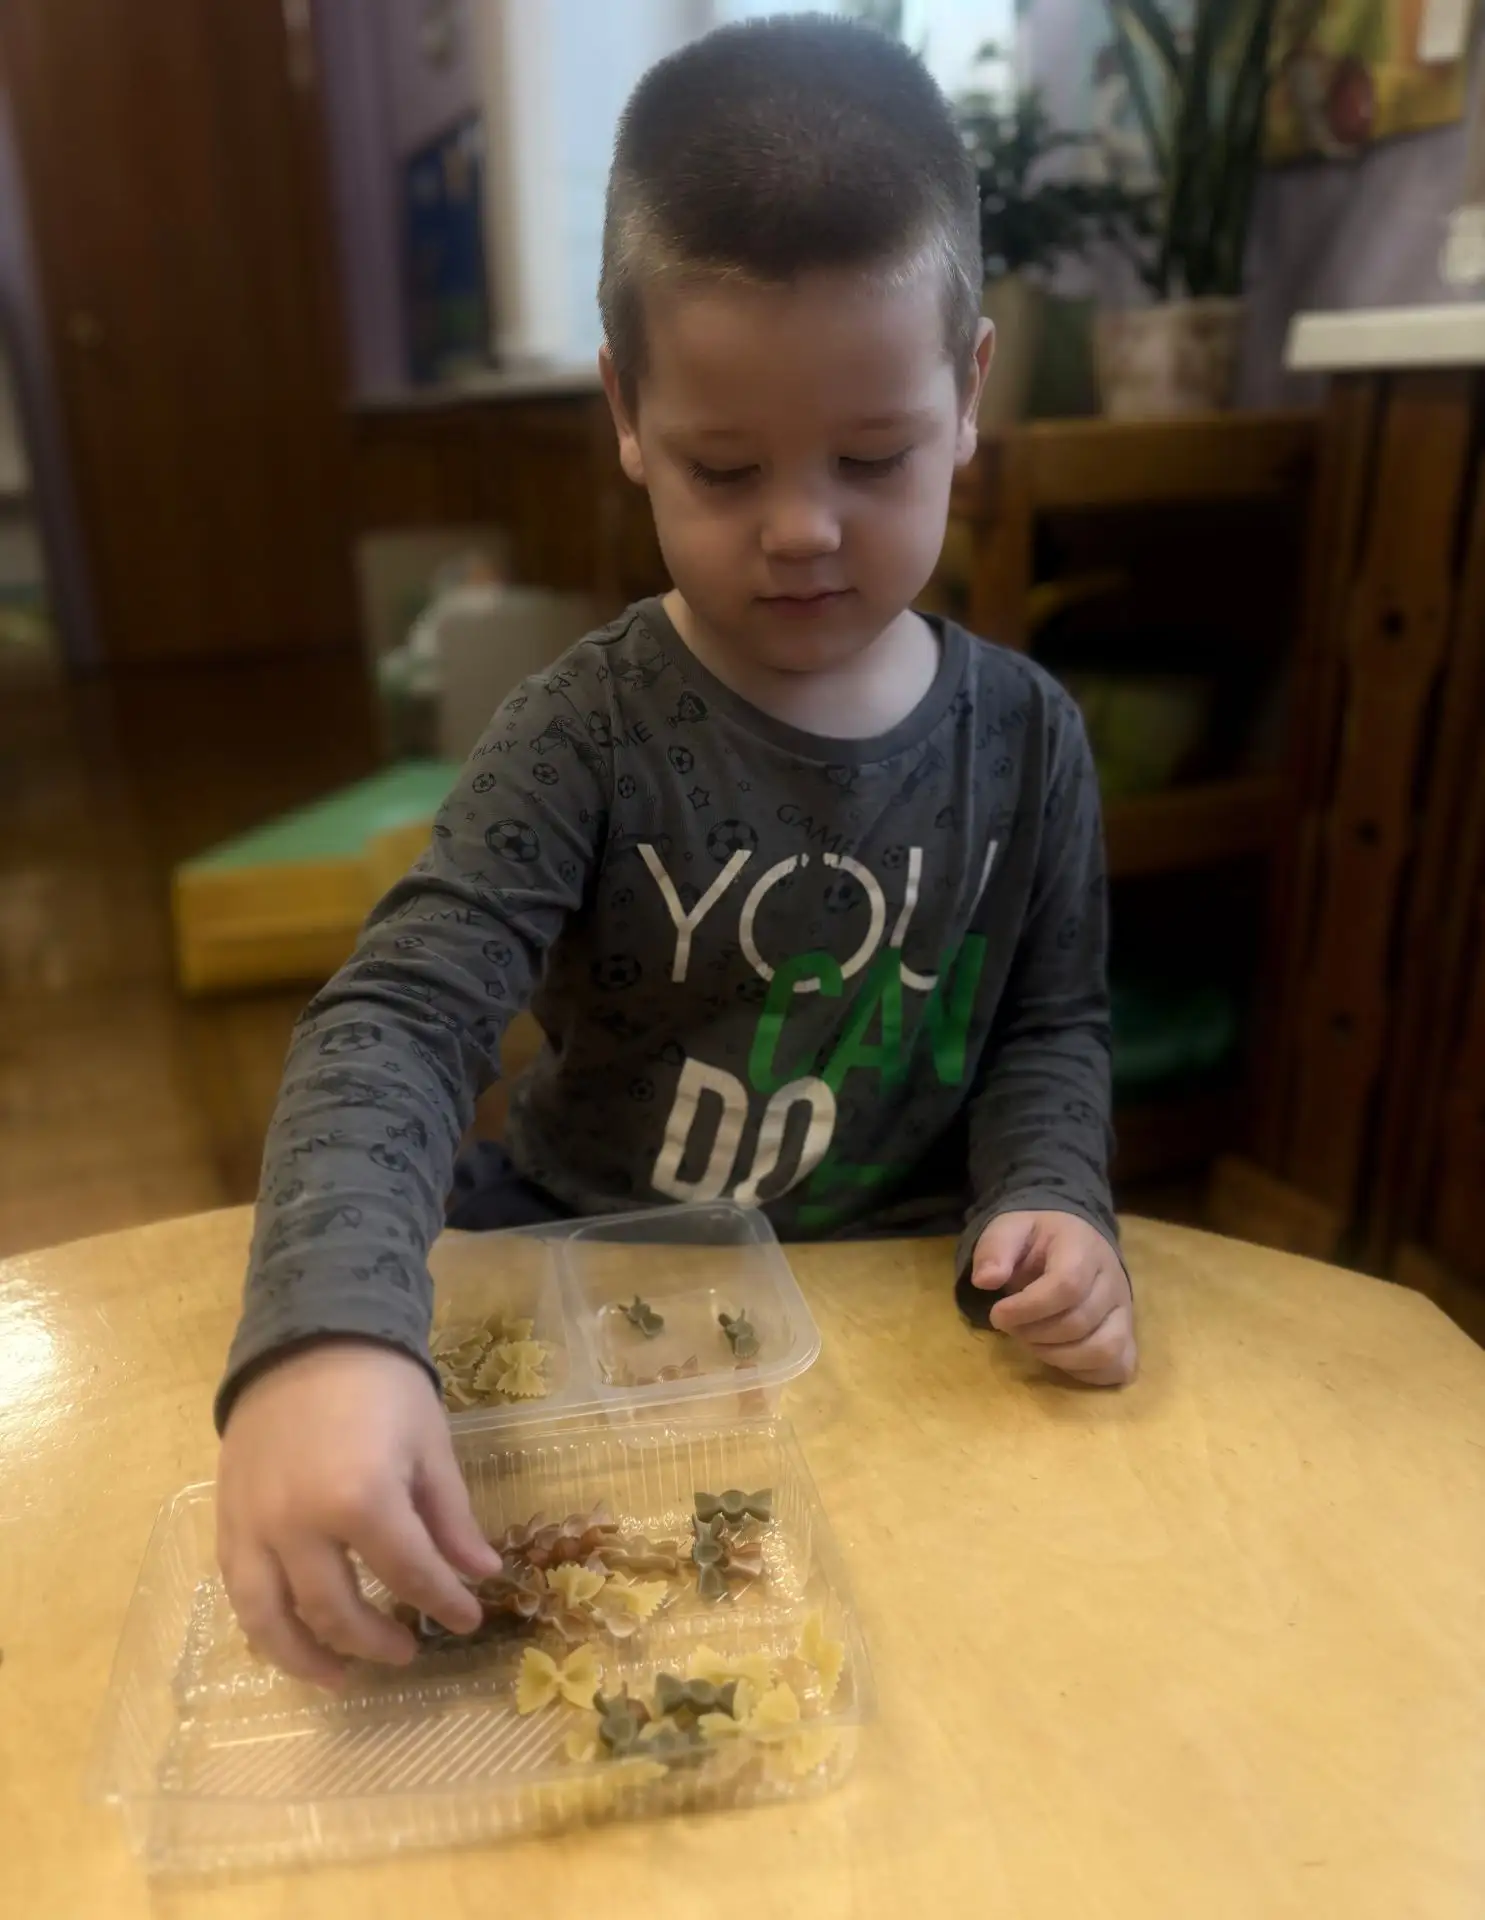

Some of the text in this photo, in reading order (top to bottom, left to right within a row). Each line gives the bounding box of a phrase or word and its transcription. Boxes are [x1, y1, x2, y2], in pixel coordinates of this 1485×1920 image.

[637, 840, 998, 993] YOU
[748, 932, 988, 1096] CAN
[650, 1056, 838, 1210] DO
